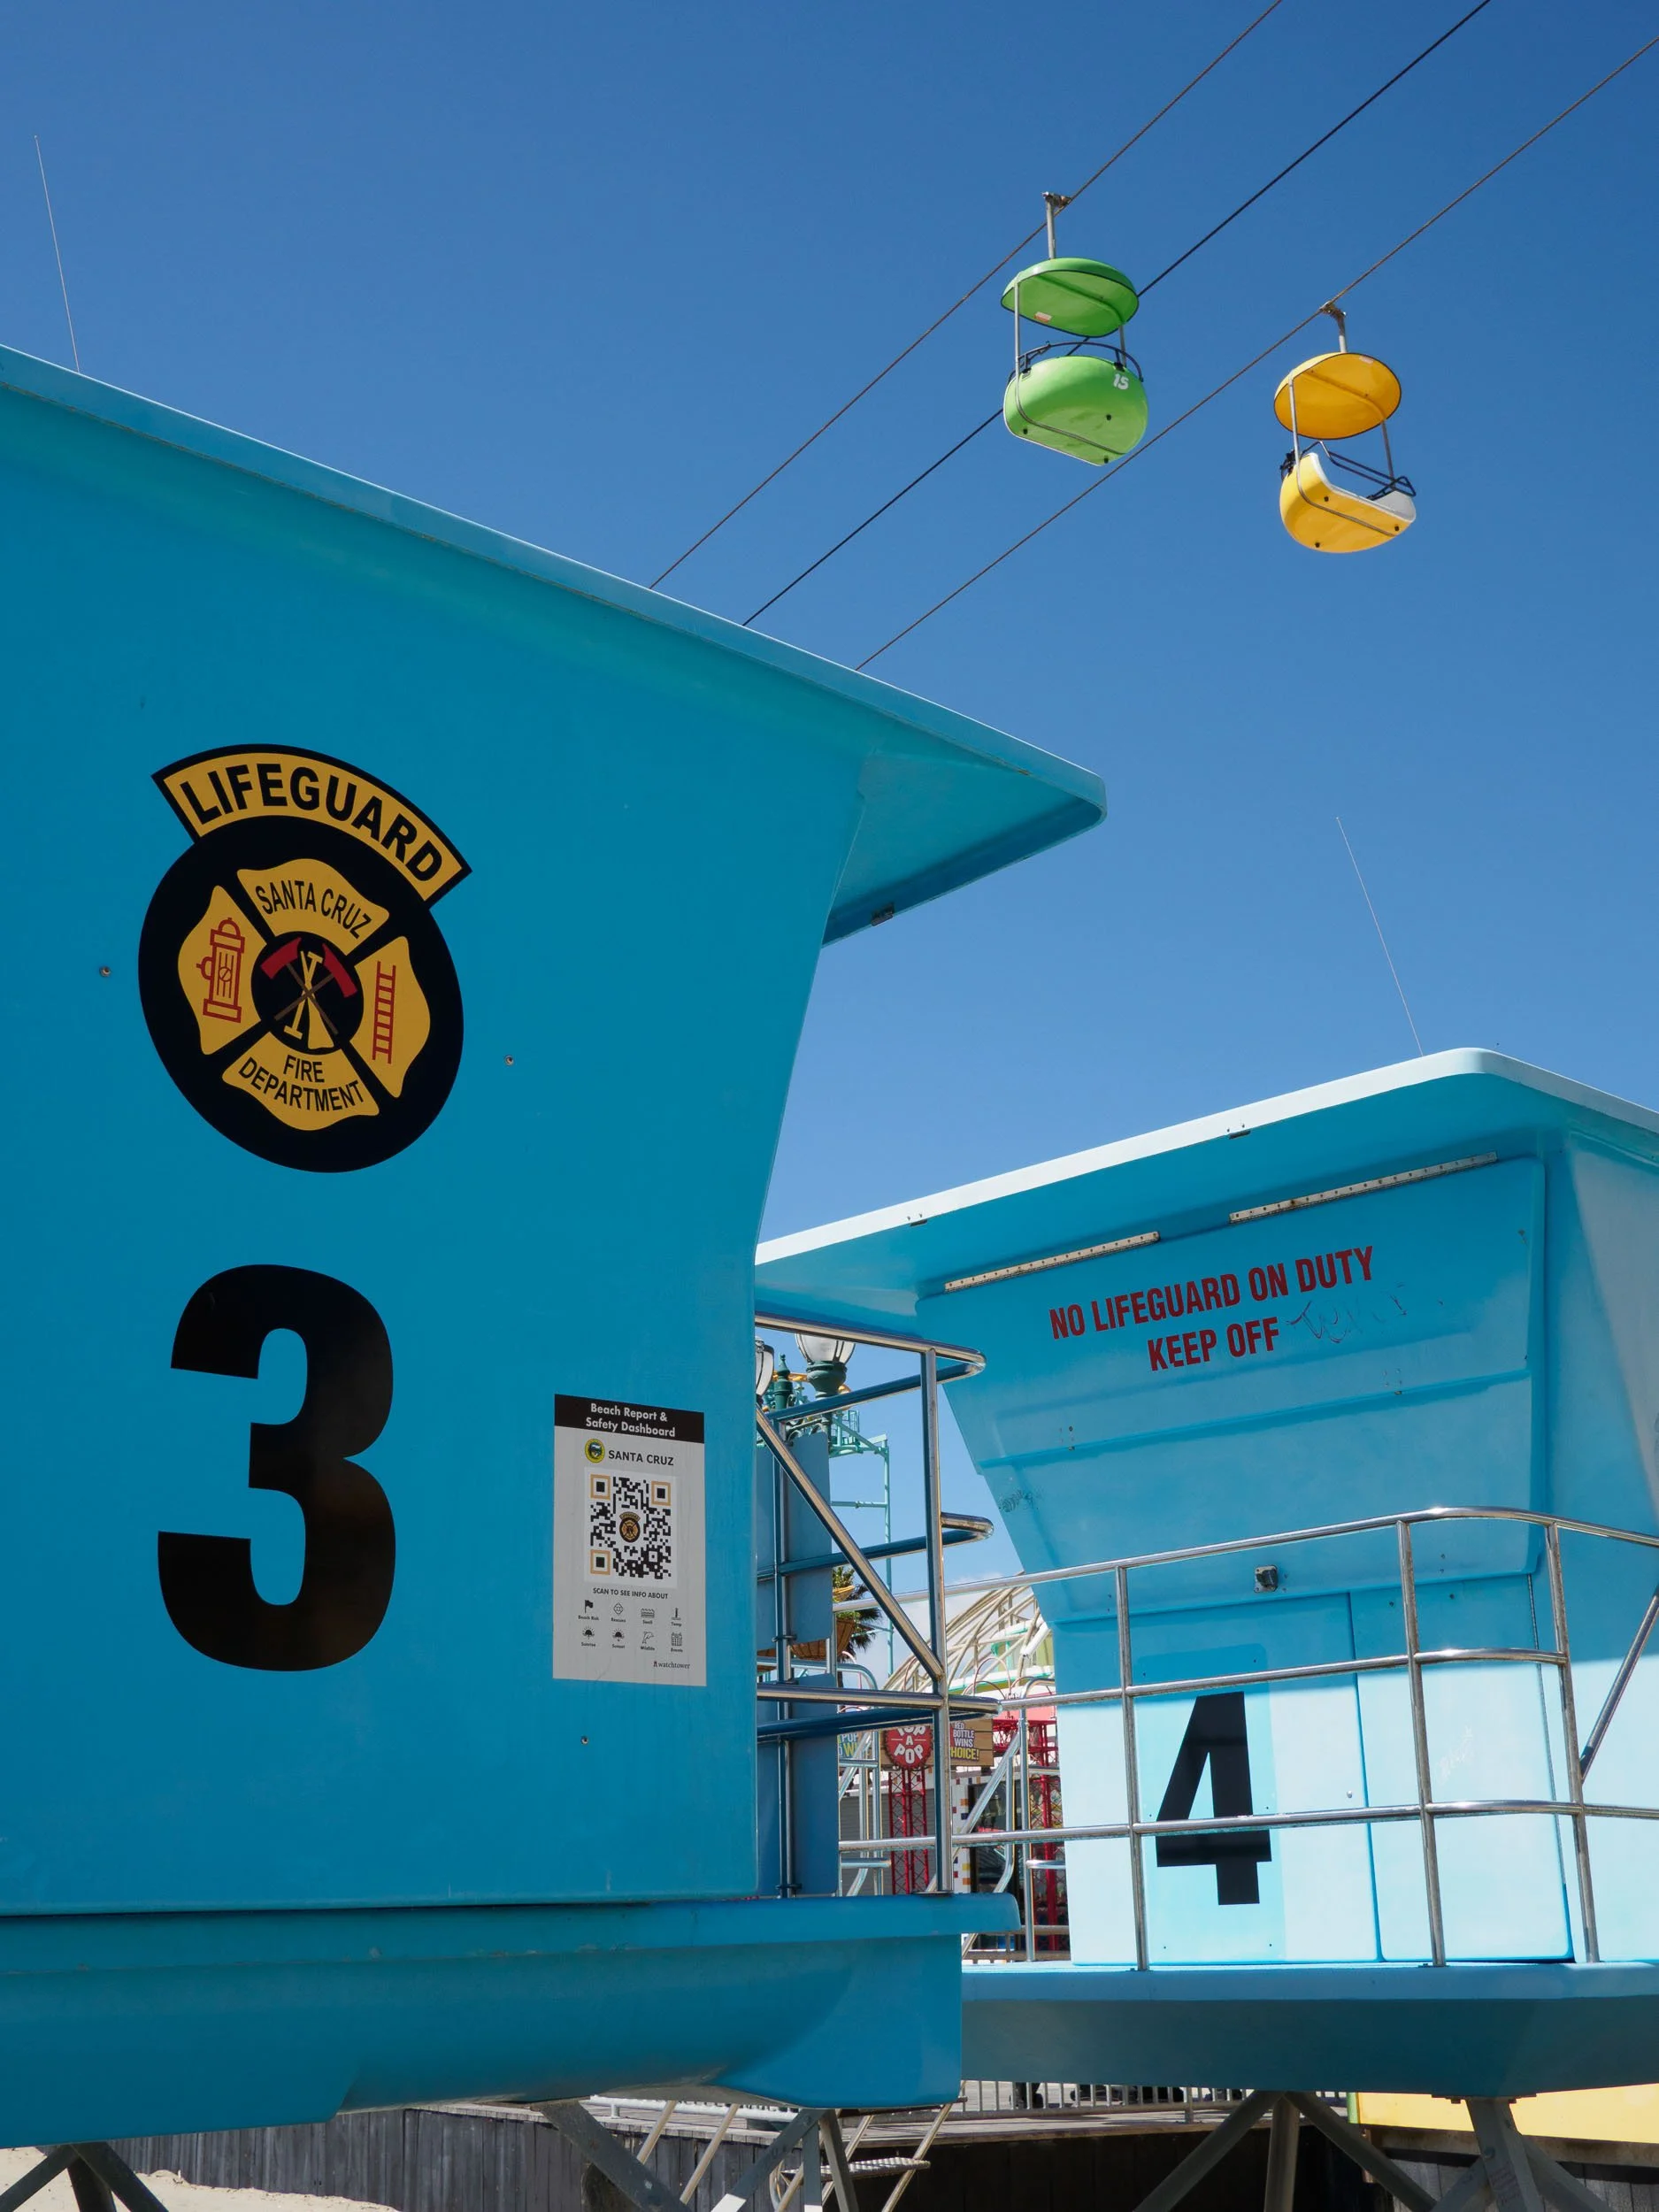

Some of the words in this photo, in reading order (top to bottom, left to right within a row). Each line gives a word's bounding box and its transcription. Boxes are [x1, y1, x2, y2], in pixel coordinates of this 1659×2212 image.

[1113, 373, 1129, 389] 15
[180, 763, 443, 882] LIFEGUARD
[255, 879, 316, 915] SANTA
[320, 888, 373, 940] CRUZ
[283, 1054, 325, 1083] FIRE
[238, 1056, 365, 1112] DEPARTMENT
[1048, 1304, 1085, 1340] NO
[1091, 1273, 1240, 1333] LIFEGUARD
[1248, 1263, 1289, 1301] ON
[1295, 1246, 1373, 1293] DUTY
[1147, 1328, 1217, 1371] KEEP
[1226, 1317, 1279, 1357] OFF
[590, 1402, 621, 1416] Beach
[624, 1407, 657, 1421] Report
[659, 1411, 667, 1422] &
[585, 1417, 618, 1432] Safety
[621, 1421, 675, 1437] Dashboard
[157, 1263, 396, 1671] 3
[608, 1449, 643, 1462] SANTA
[646, 1455, 674, 1465] CRUZ
[905, 1735, 913, 1746] A
[953, 1729, 974, 1739] BOTTLE
[954, 1738, 973, 1747] WINS
[894, 1743, 924, 1764] POP
[949, 1747, 979, 1761] HOICE!
[1156, 1691, 1271, 1905] 4
